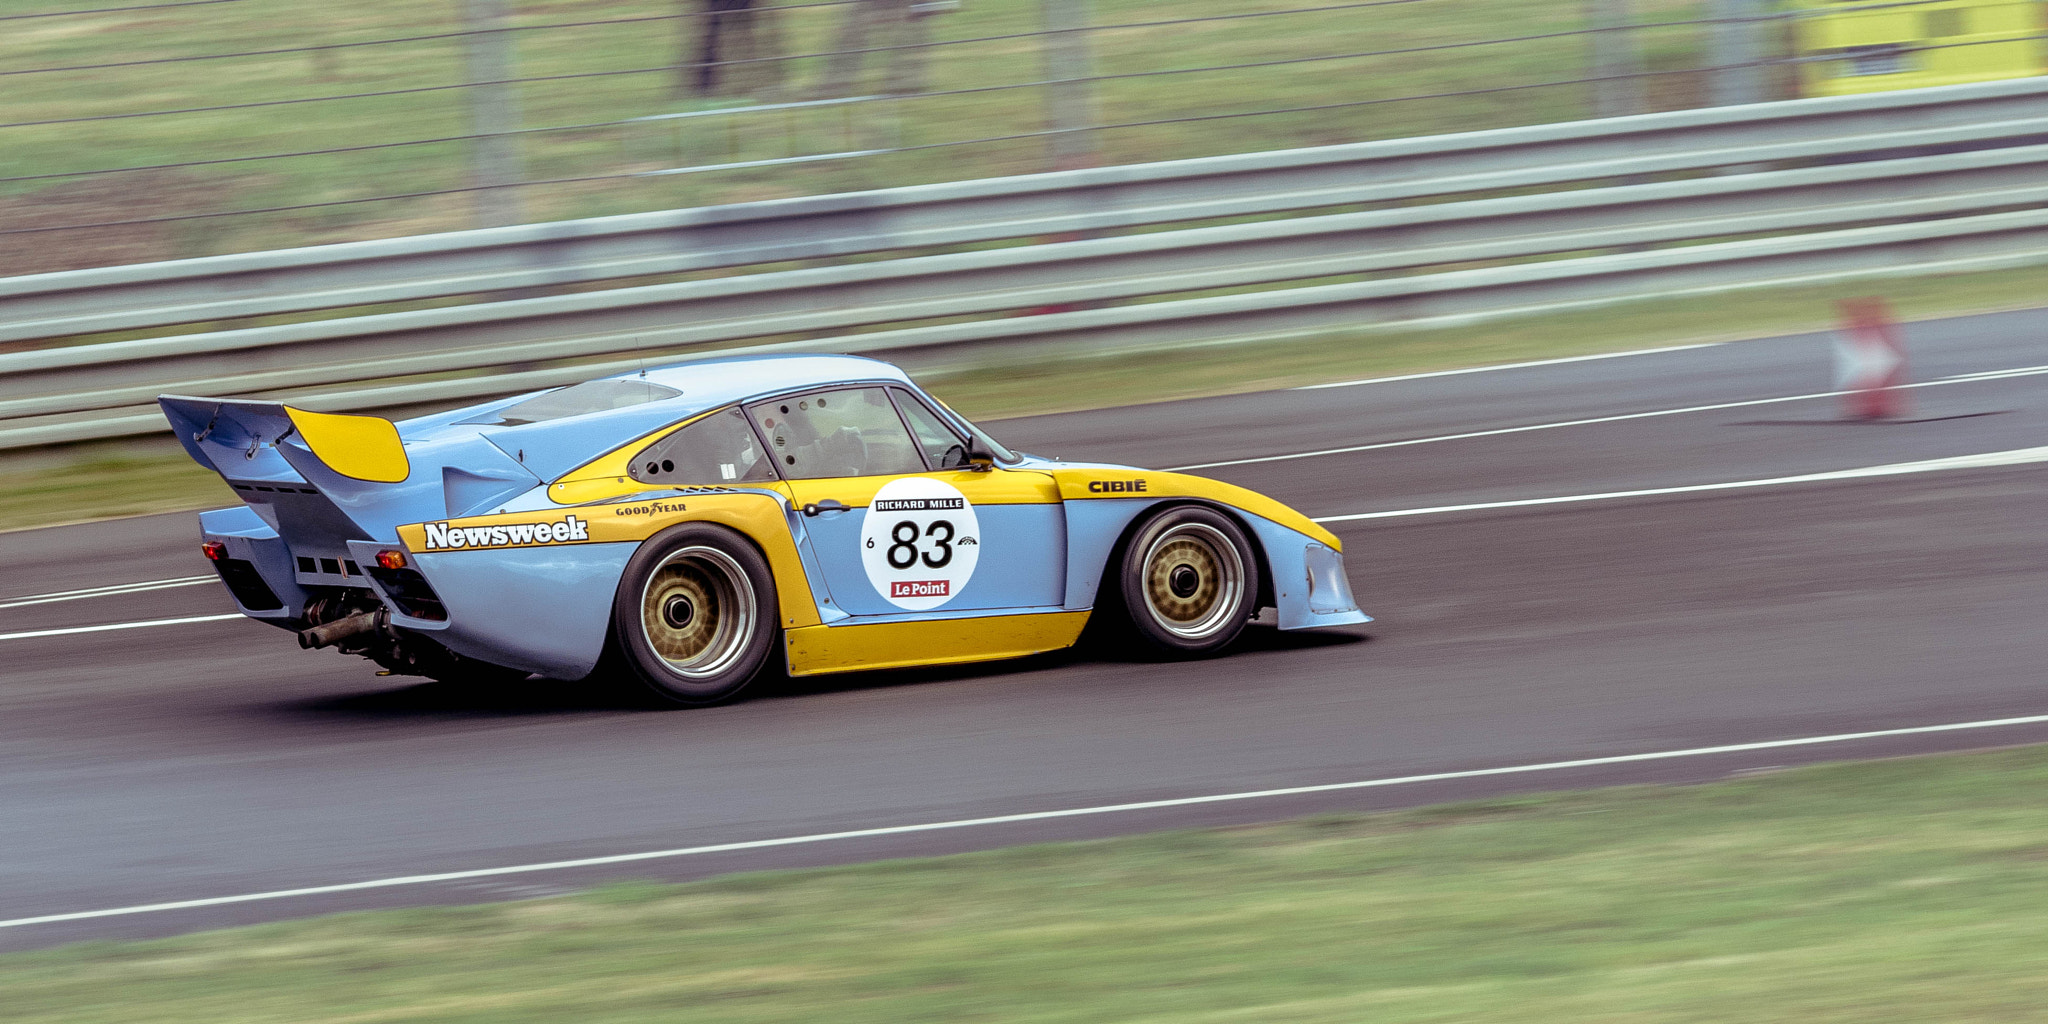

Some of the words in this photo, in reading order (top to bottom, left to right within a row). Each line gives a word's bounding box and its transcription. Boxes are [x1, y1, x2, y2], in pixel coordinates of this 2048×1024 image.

[877, 500, 925, 510] RICHARD
[929, 499, 962, 508] MILLE
[423, 515, 589, 550] Newsweek
[866, 537, 875, 549] 6
[886, 520, 955, 570] 83
[895, 584, 910, 595] Le
[911, 582, 945, 595] Point
